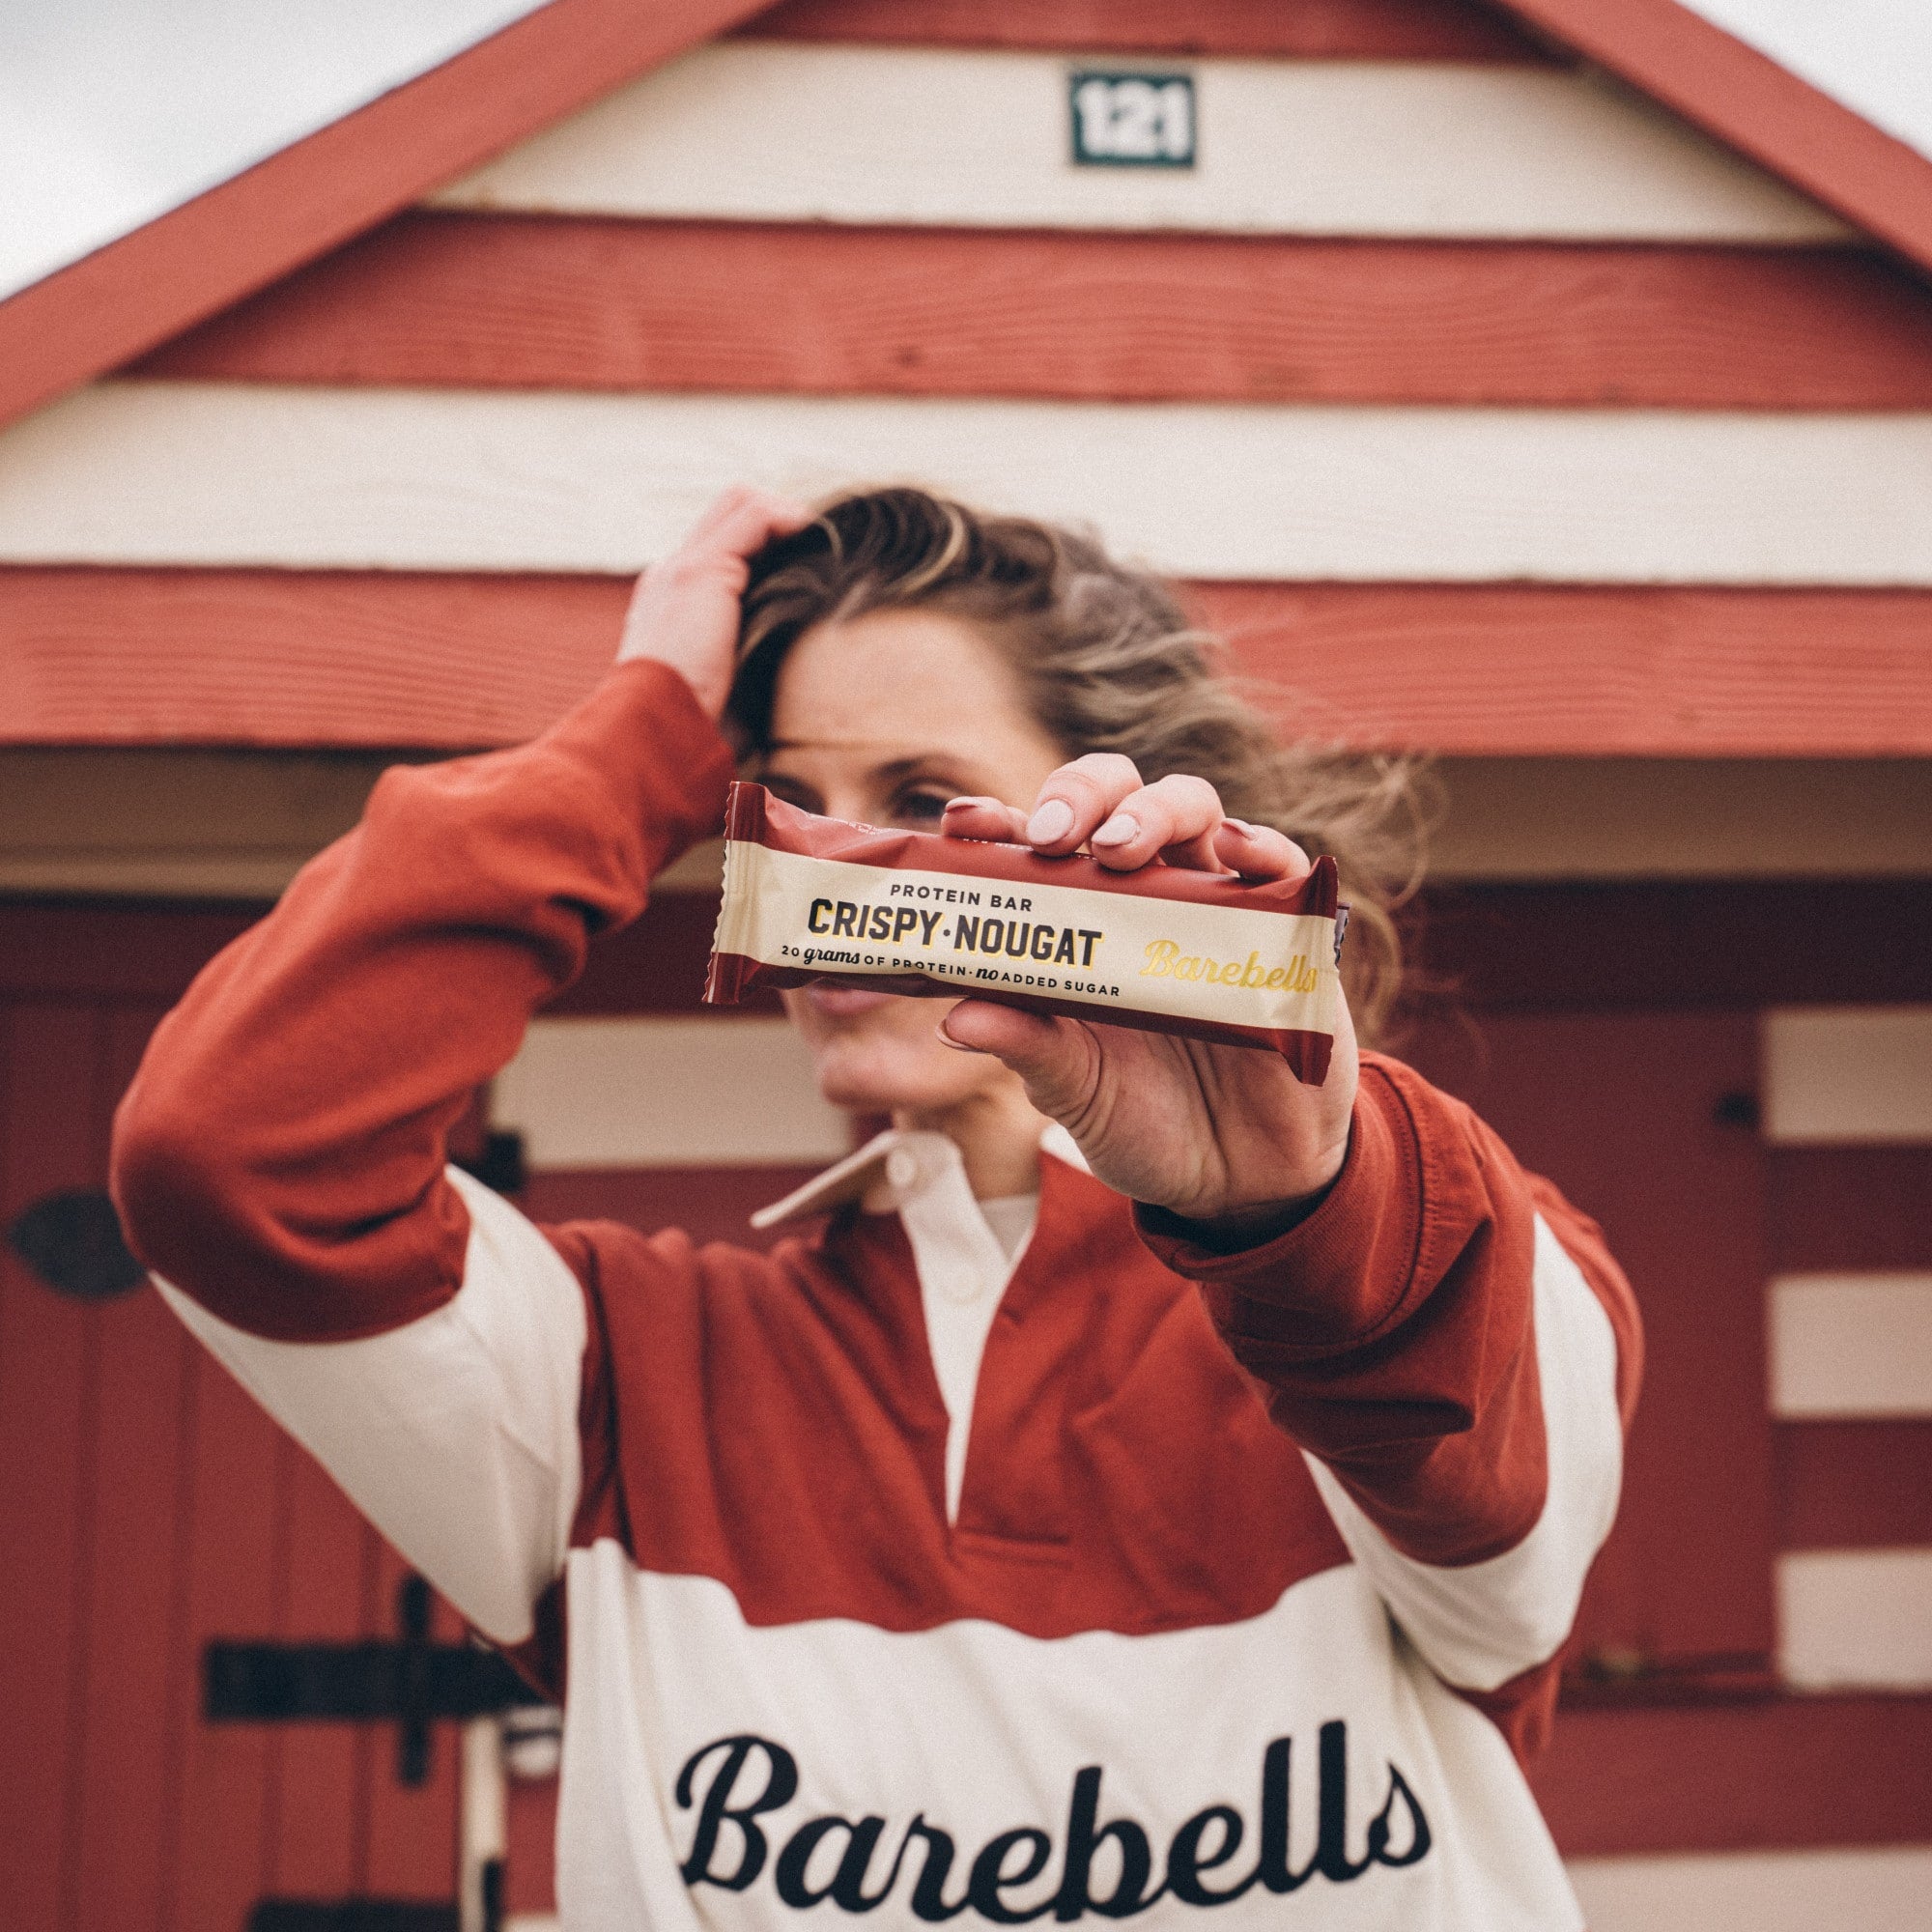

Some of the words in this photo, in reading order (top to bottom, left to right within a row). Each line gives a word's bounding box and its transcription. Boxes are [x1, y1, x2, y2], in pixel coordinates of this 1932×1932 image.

[1078, 80, 1189, 158] 121
[890, 884, 980, 906] PROTEIN
[990, 895, 1033, 912] BAR
[808, 897, 944, 948] CRISPY
[953, 914, 1104, 969] NOUGAT
[781, 945, 800, 957] 20
[804, 948, 861, 964] grams
[865, 955, 886, 966] OF
[893, 958, 966, 976] PROTEIN
[976, 968, 999, 980] no
[1001, 972, 1058, 988] ADDED
[1064, 980, 1120, 996] SUGAR
[1139, 939, 1318, 994] Barebells
[674, 1719, 1432, 1923] Barebells
